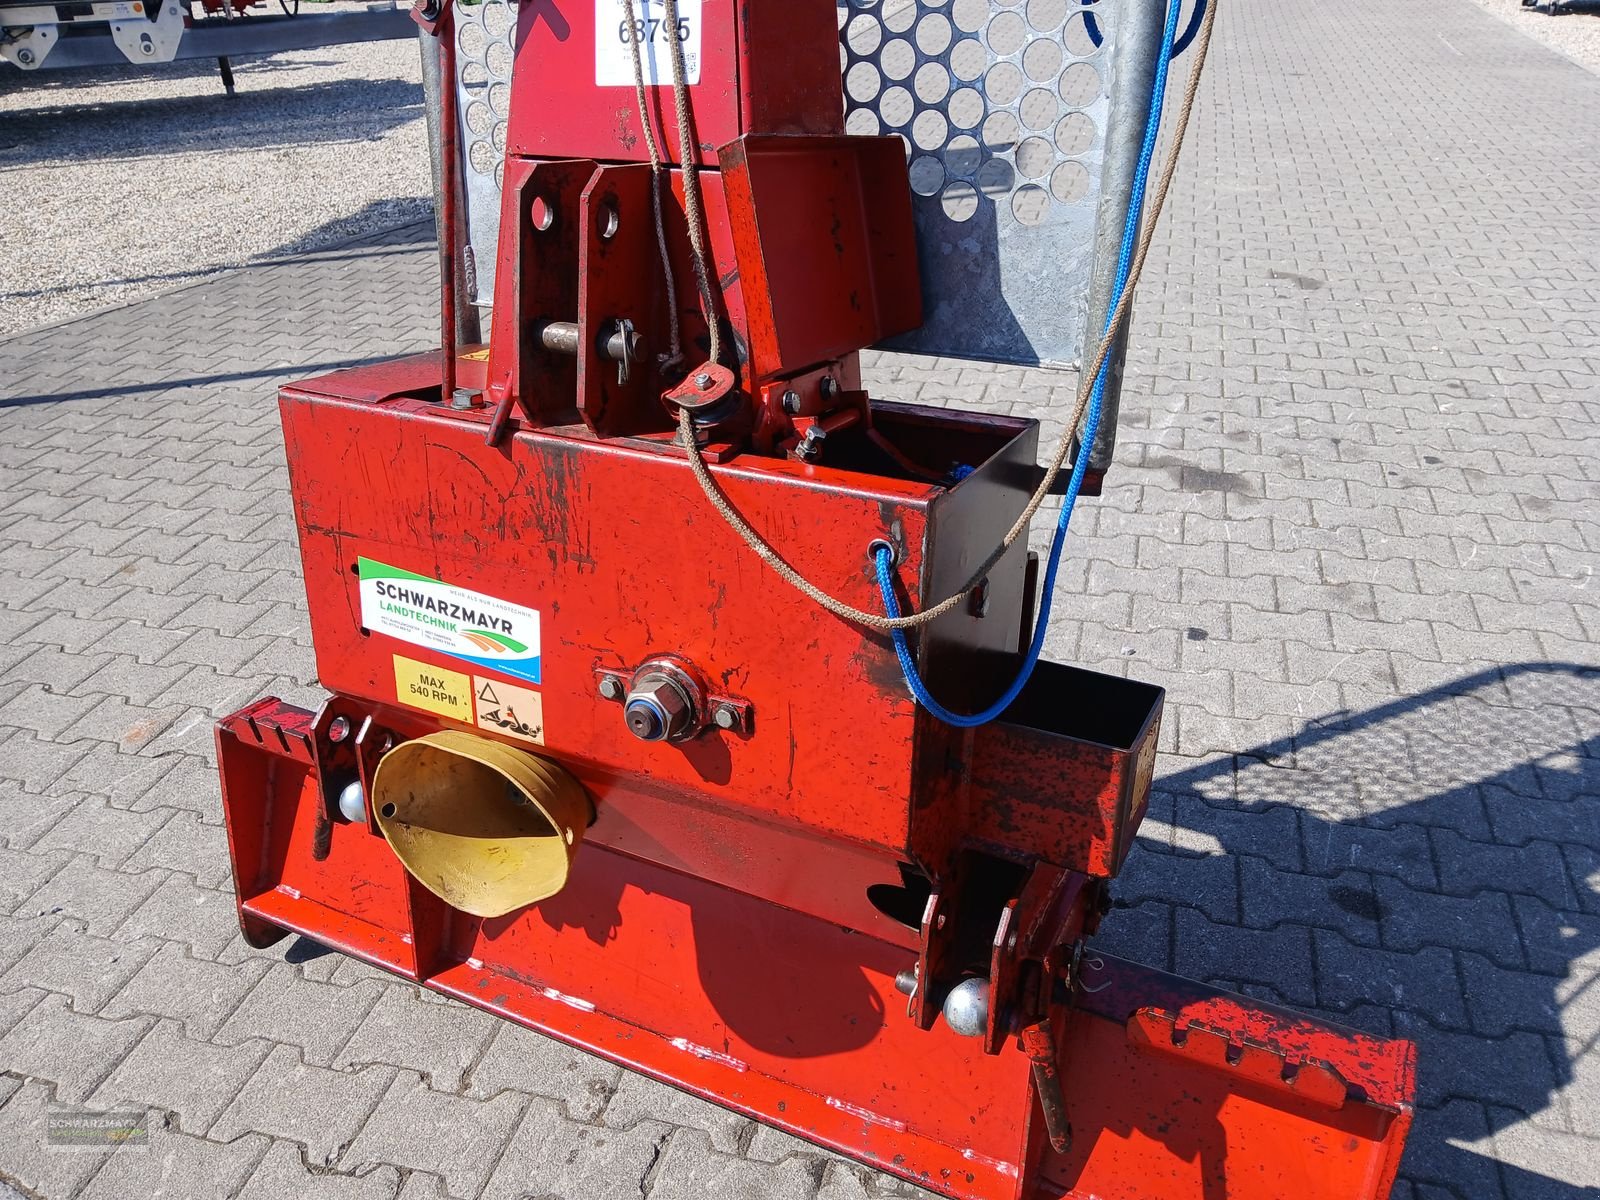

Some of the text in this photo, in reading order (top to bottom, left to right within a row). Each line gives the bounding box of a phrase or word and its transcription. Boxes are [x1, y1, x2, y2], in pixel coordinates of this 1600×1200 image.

[376, 580, 513, 635] SCHWARZMAYR
[379, 600, 458, 633] LANDTECHNIK
[410, 683, 458, 706] 540 RPM
[420, 673, 446, 691] MAX
